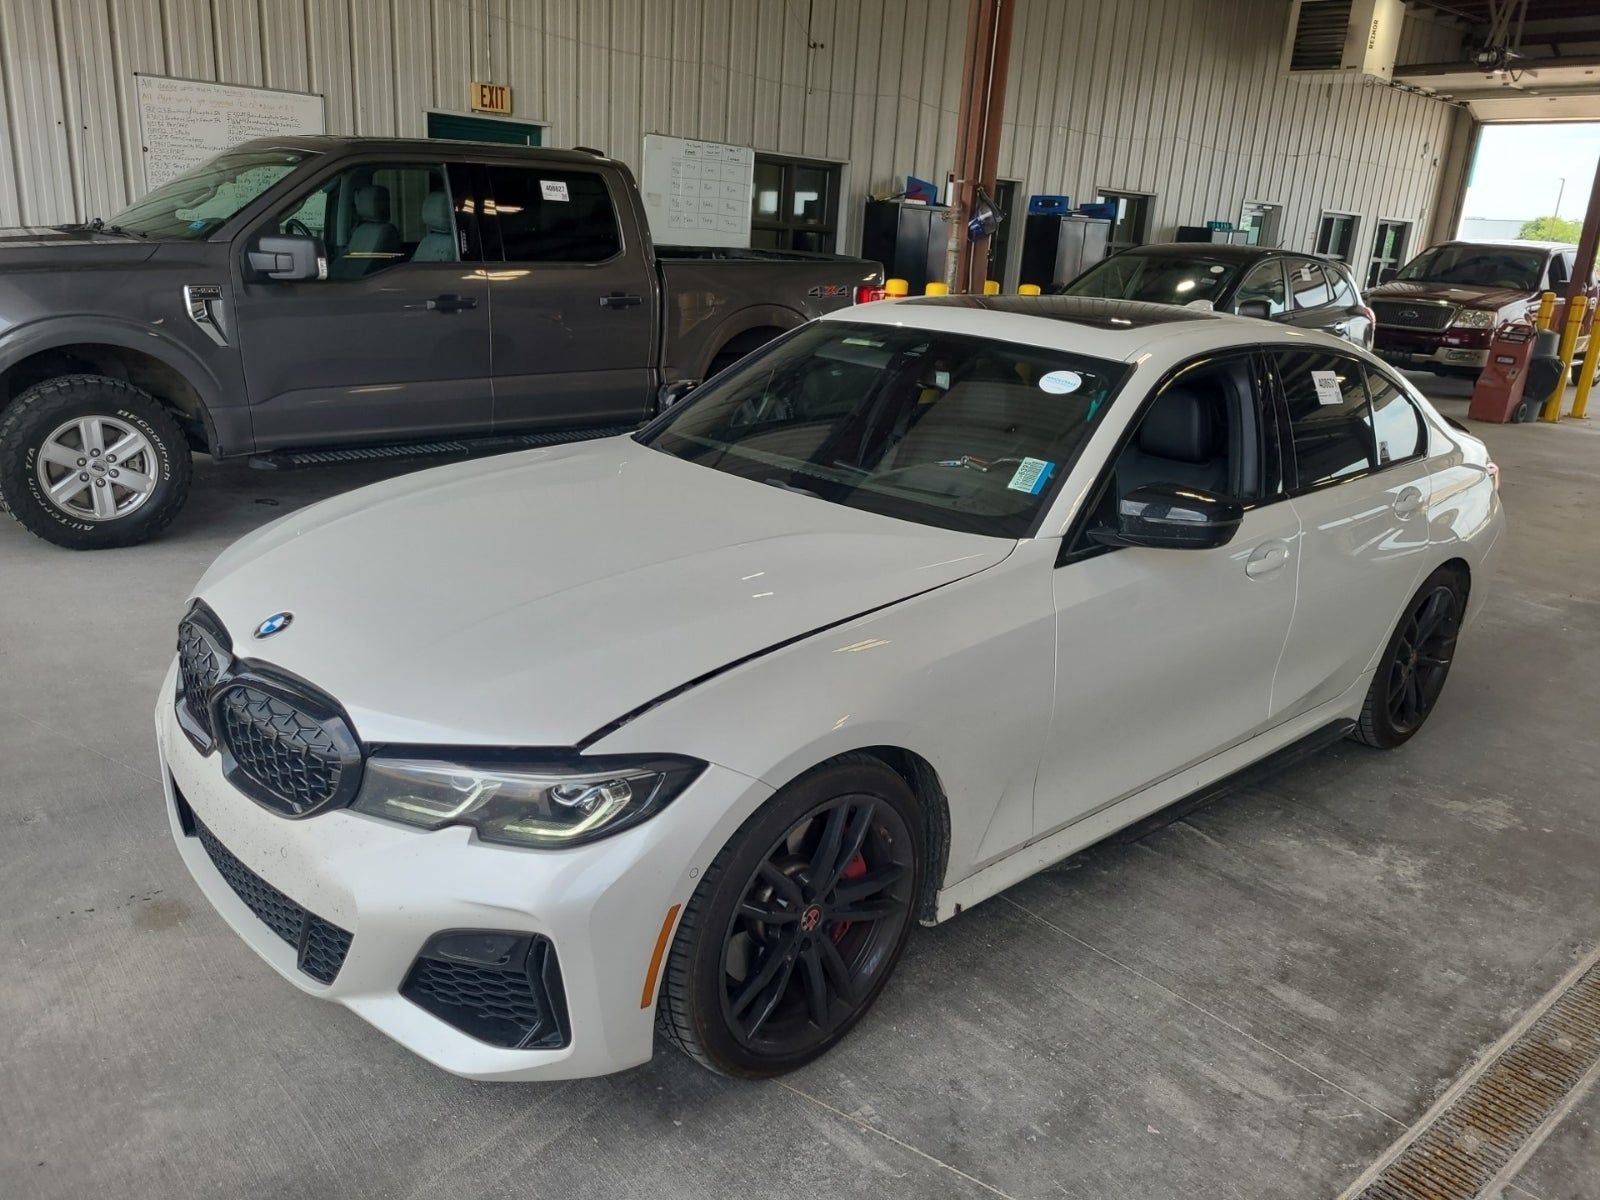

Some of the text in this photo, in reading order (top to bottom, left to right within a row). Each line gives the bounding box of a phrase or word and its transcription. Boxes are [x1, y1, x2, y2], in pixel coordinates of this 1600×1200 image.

[1368, 19, 1379, 49] REZNOR
[480, 85, 506, 110] EXIT
[116, 409, 173, 481] BFGoodrich
